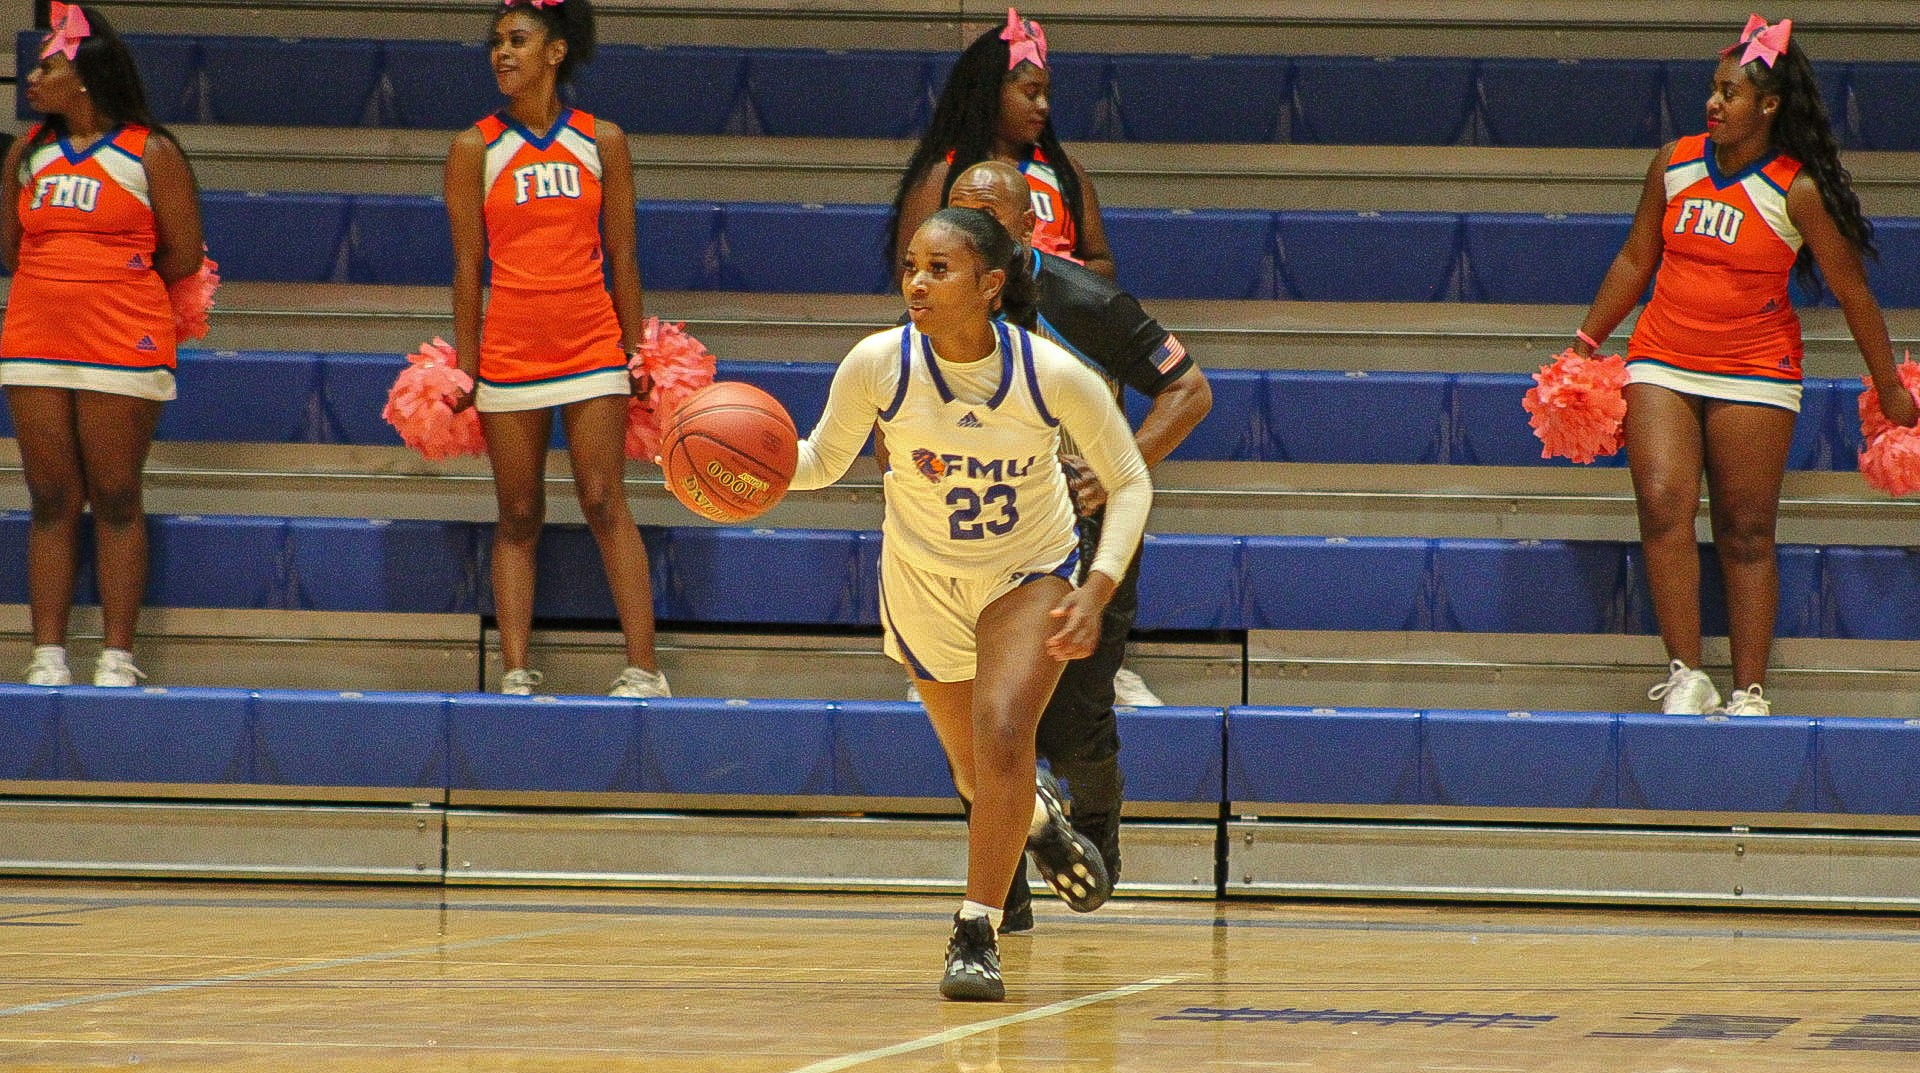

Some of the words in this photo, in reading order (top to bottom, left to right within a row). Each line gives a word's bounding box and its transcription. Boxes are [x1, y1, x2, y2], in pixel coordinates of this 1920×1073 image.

[30, 174, 102, 212] FMU
[514, 162, 581, 206] FMU
[1674, 198, 1745, 245] FMU
[707, 461, 758, 499] 1000
[945, 453, 1036, 483] FMU
[945, 484, 1020, 540] 23
